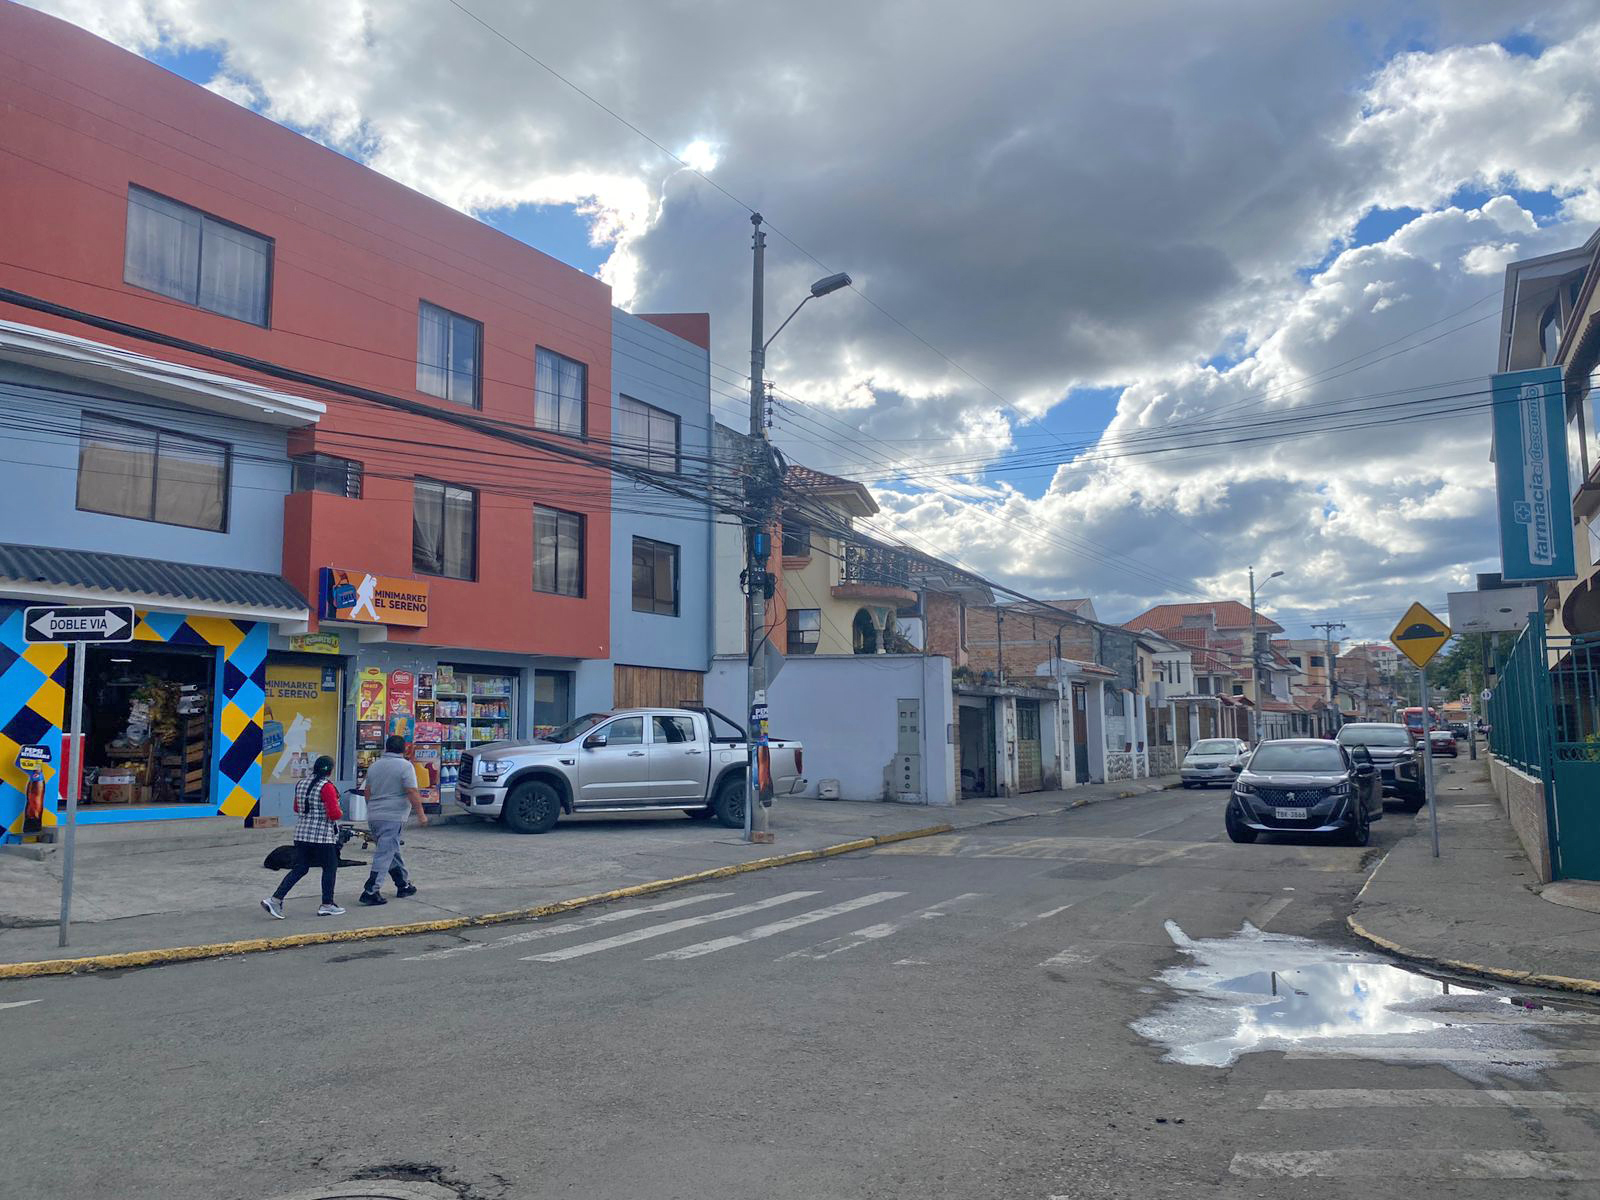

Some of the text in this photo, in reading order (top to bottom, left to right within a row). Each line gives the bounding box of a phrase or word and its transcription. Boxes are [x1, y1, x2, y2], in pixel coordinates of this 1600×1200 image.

[1530, 474, 1547, 560] farmacia
[375, 590, 427, 603] MINIMARKET
[375, 598, 427, 612] EL SERENO
[50, 618, 107, 630] DOBLE VIA
[264, 680, 320, 690] MINIMARKET
[264, 688, 318, 699] EL SERENO
